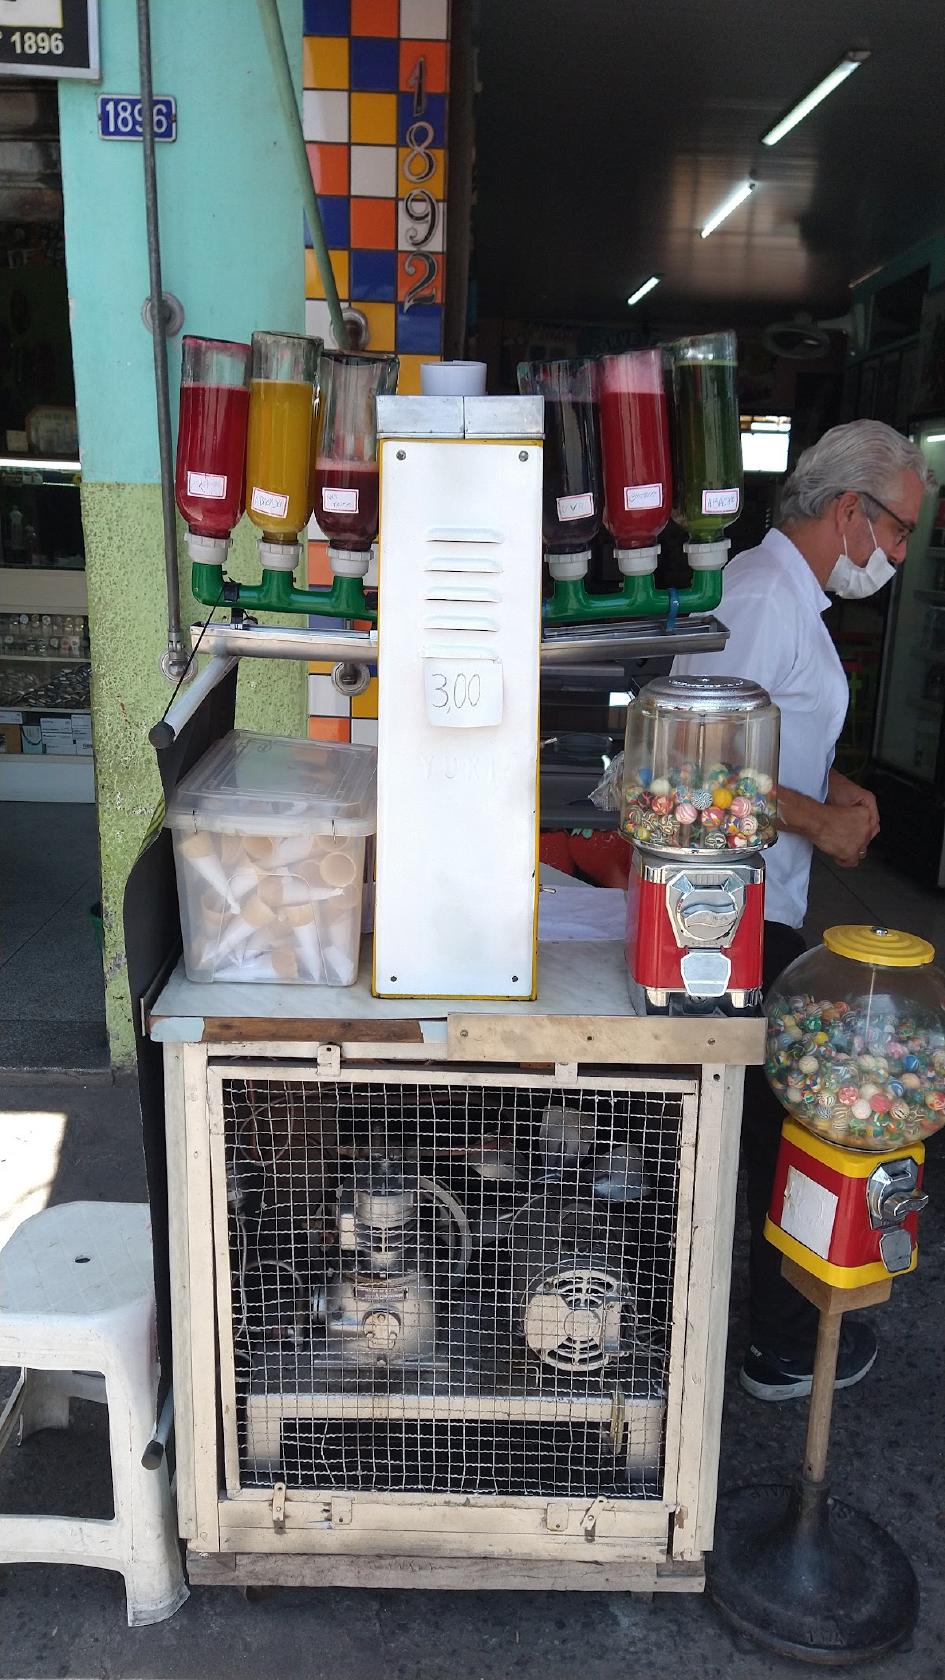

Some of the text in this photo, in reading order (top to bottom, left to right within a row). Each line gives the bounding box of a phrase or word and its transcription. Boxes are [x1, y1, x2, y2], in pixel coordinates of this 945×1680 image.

[10, 31, 65, 55] 1896
[105, 100, 168, 134] 1896
[431, 672, 481, 714] 3,00
